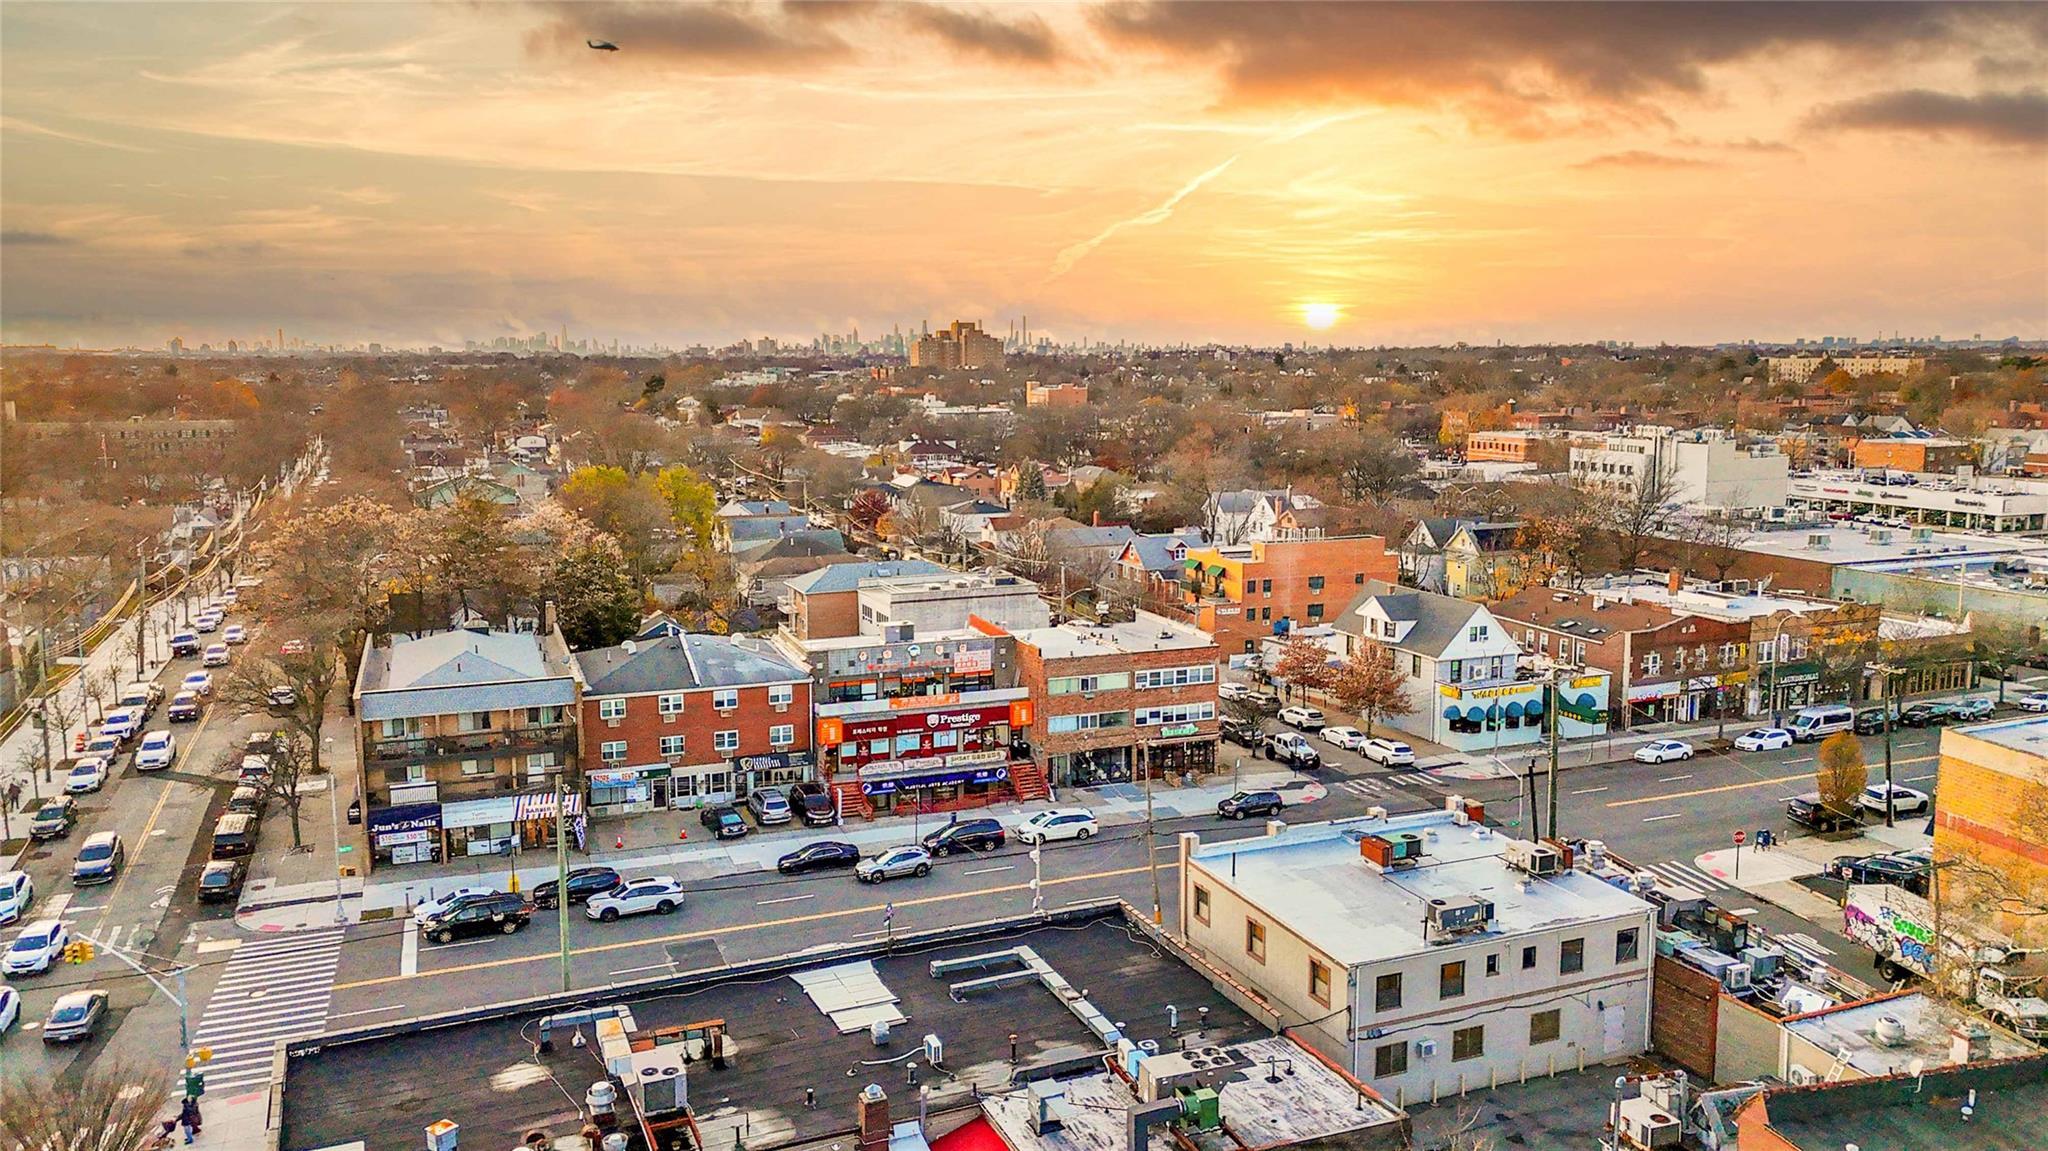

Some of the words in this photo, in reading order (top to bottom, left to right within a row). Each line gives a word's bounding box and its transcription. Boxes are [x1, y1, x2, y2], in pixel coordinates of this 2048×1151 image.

[940, 713, 981, 724] Prestige
[371, 823, 399, 832] Jun's
[410, 819, 437, 828] Nails
